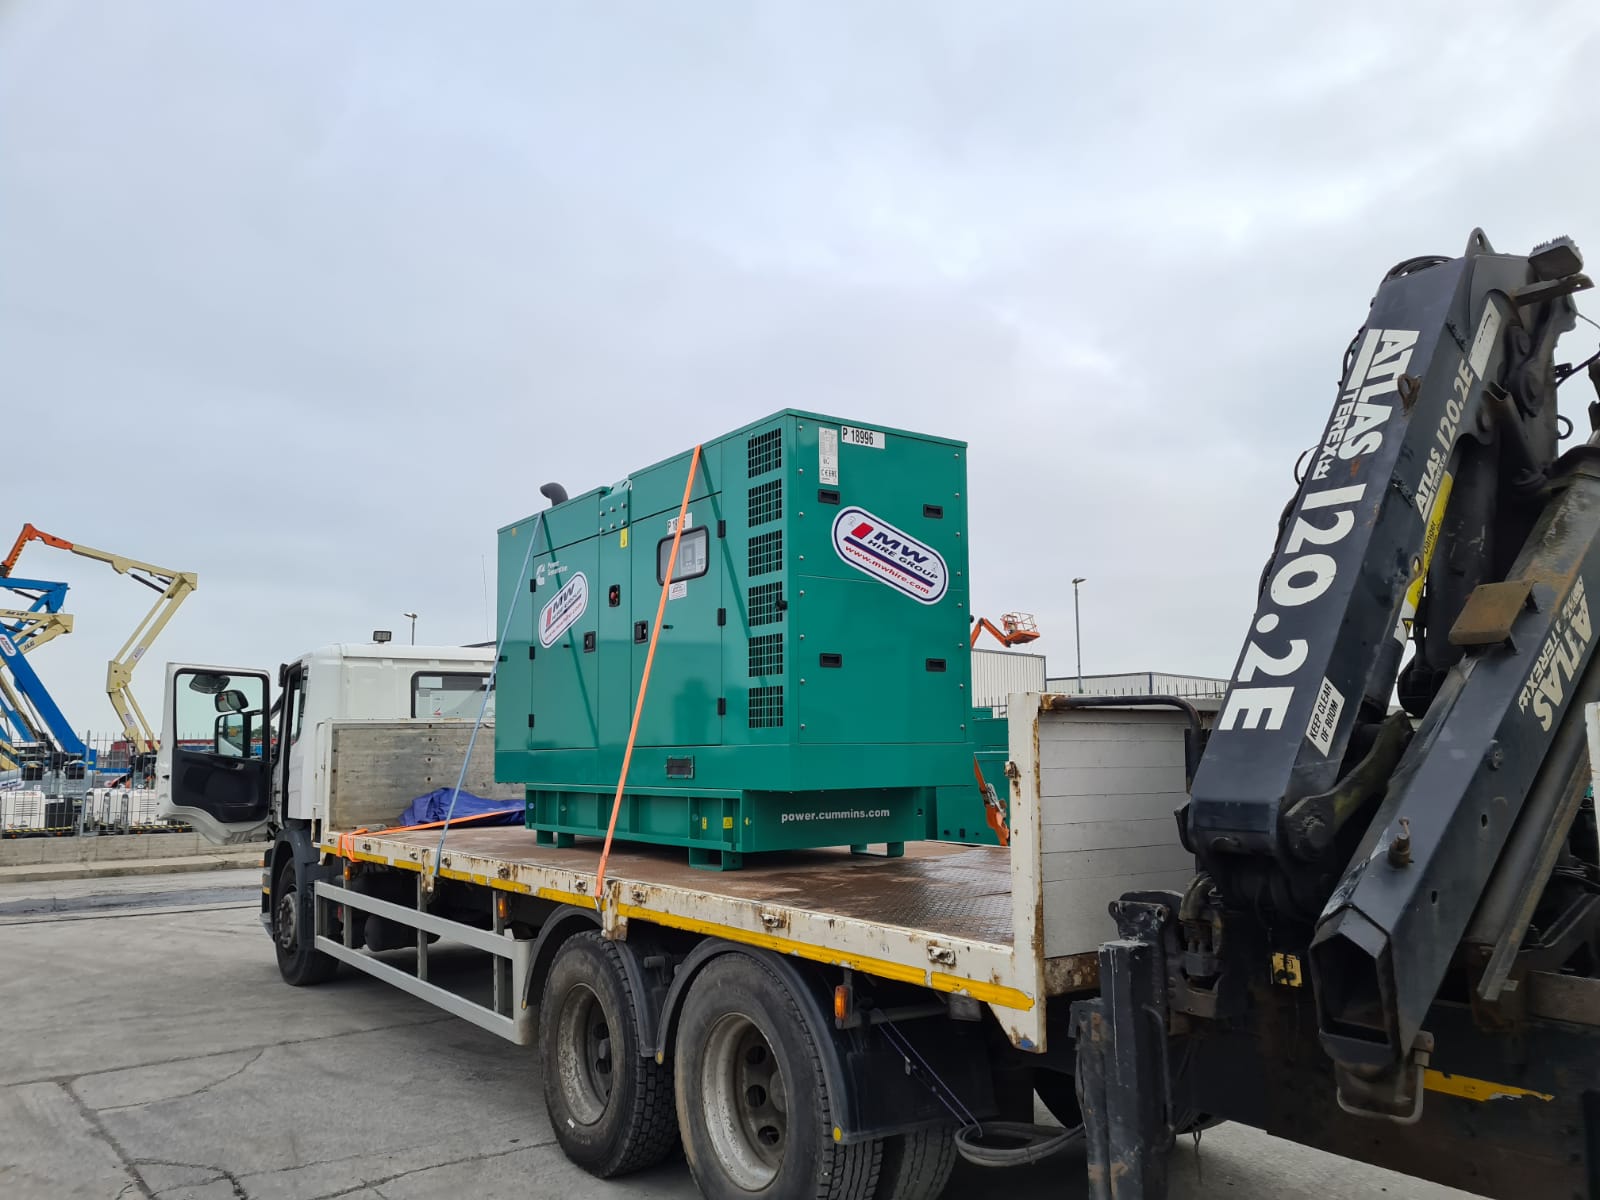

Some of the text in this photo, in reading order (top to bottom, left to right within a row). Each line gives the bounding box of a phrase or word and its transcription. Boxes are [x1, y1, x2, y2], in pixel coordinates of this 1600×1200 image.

[842, 427, 848, 441] P
[851, 428, 874, 445] 18996
[1319, 388, 1360, 458] TEREX
[1415, 359, 1474, 515] ATLAS 120.2E
[873, 531, 929, 564] MW
[1218, 329, 1420, 731] ATLAS 120.2E
[845, 545, 930, 595] www.mwhire.com
[867, 539, 938, 581] HIRE GROUP
[1526, 628, 1561, 697] TEREX
[1533, 592, 1593, 732] ATLAS
[1309, 682, 1333, 741] KEEP CLEAR
[1320, 698, 1339, 743] OF BOOM
[781, 808, 890, 824] power.cummins.com
